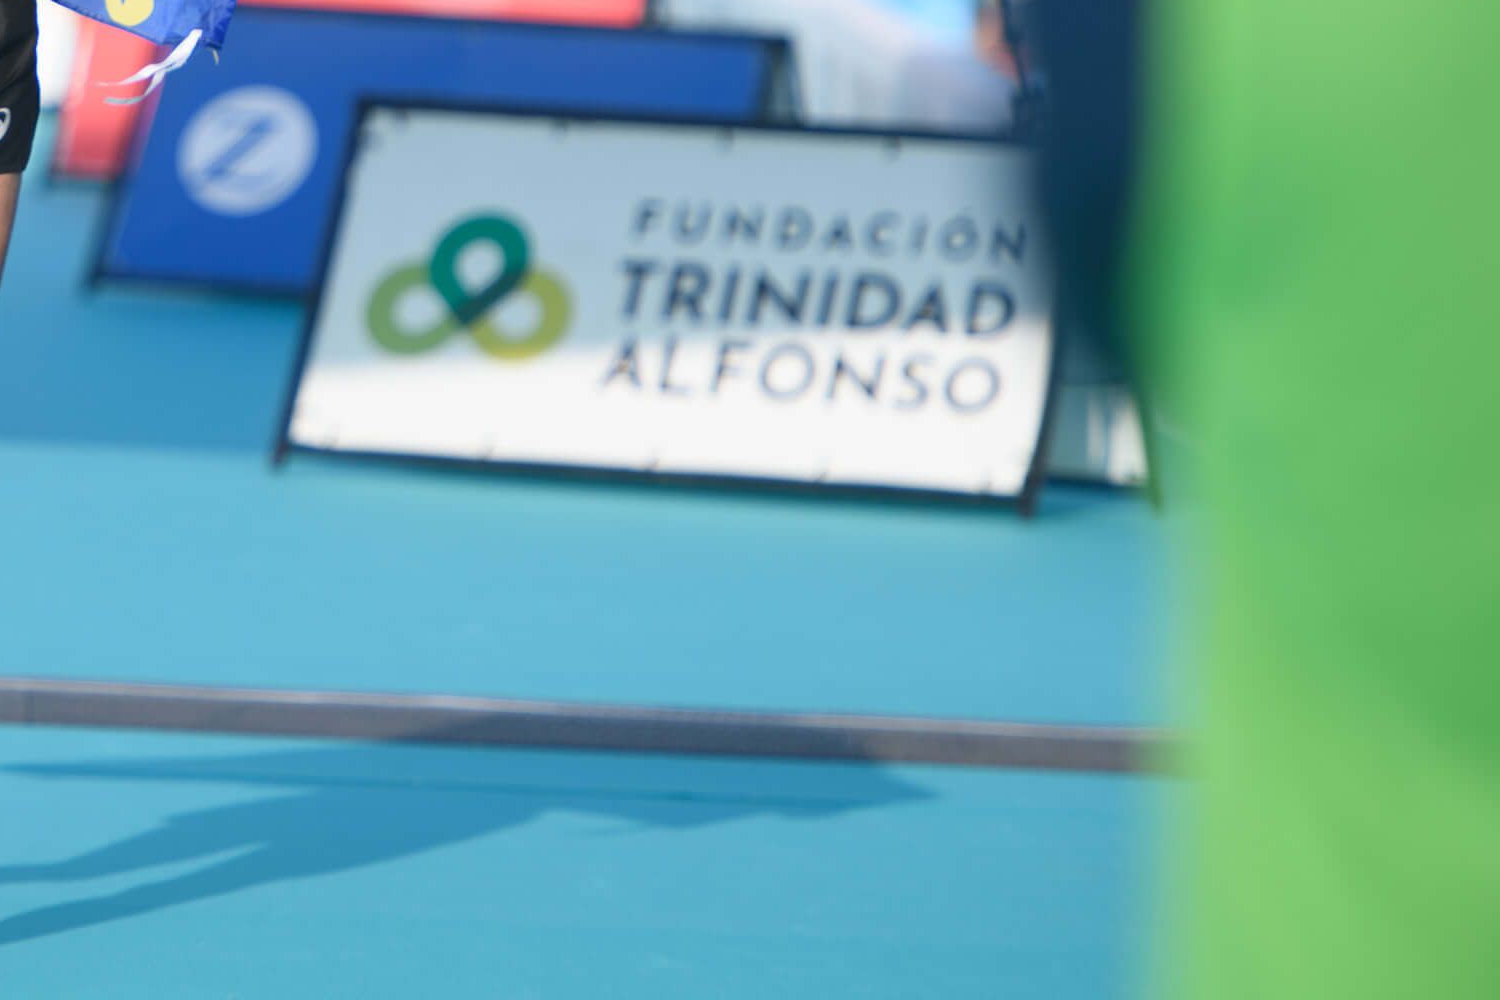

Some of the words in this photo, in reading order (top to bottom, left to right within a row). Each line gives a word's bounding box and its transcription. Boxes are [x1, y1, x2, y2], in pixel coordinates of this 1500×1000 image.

[629, 197, 1027, 265] FUNDACIÓN
[617, 257, 1017, 337] TRINIDAD
[599, 333, 1000, 413] ALFONSO
